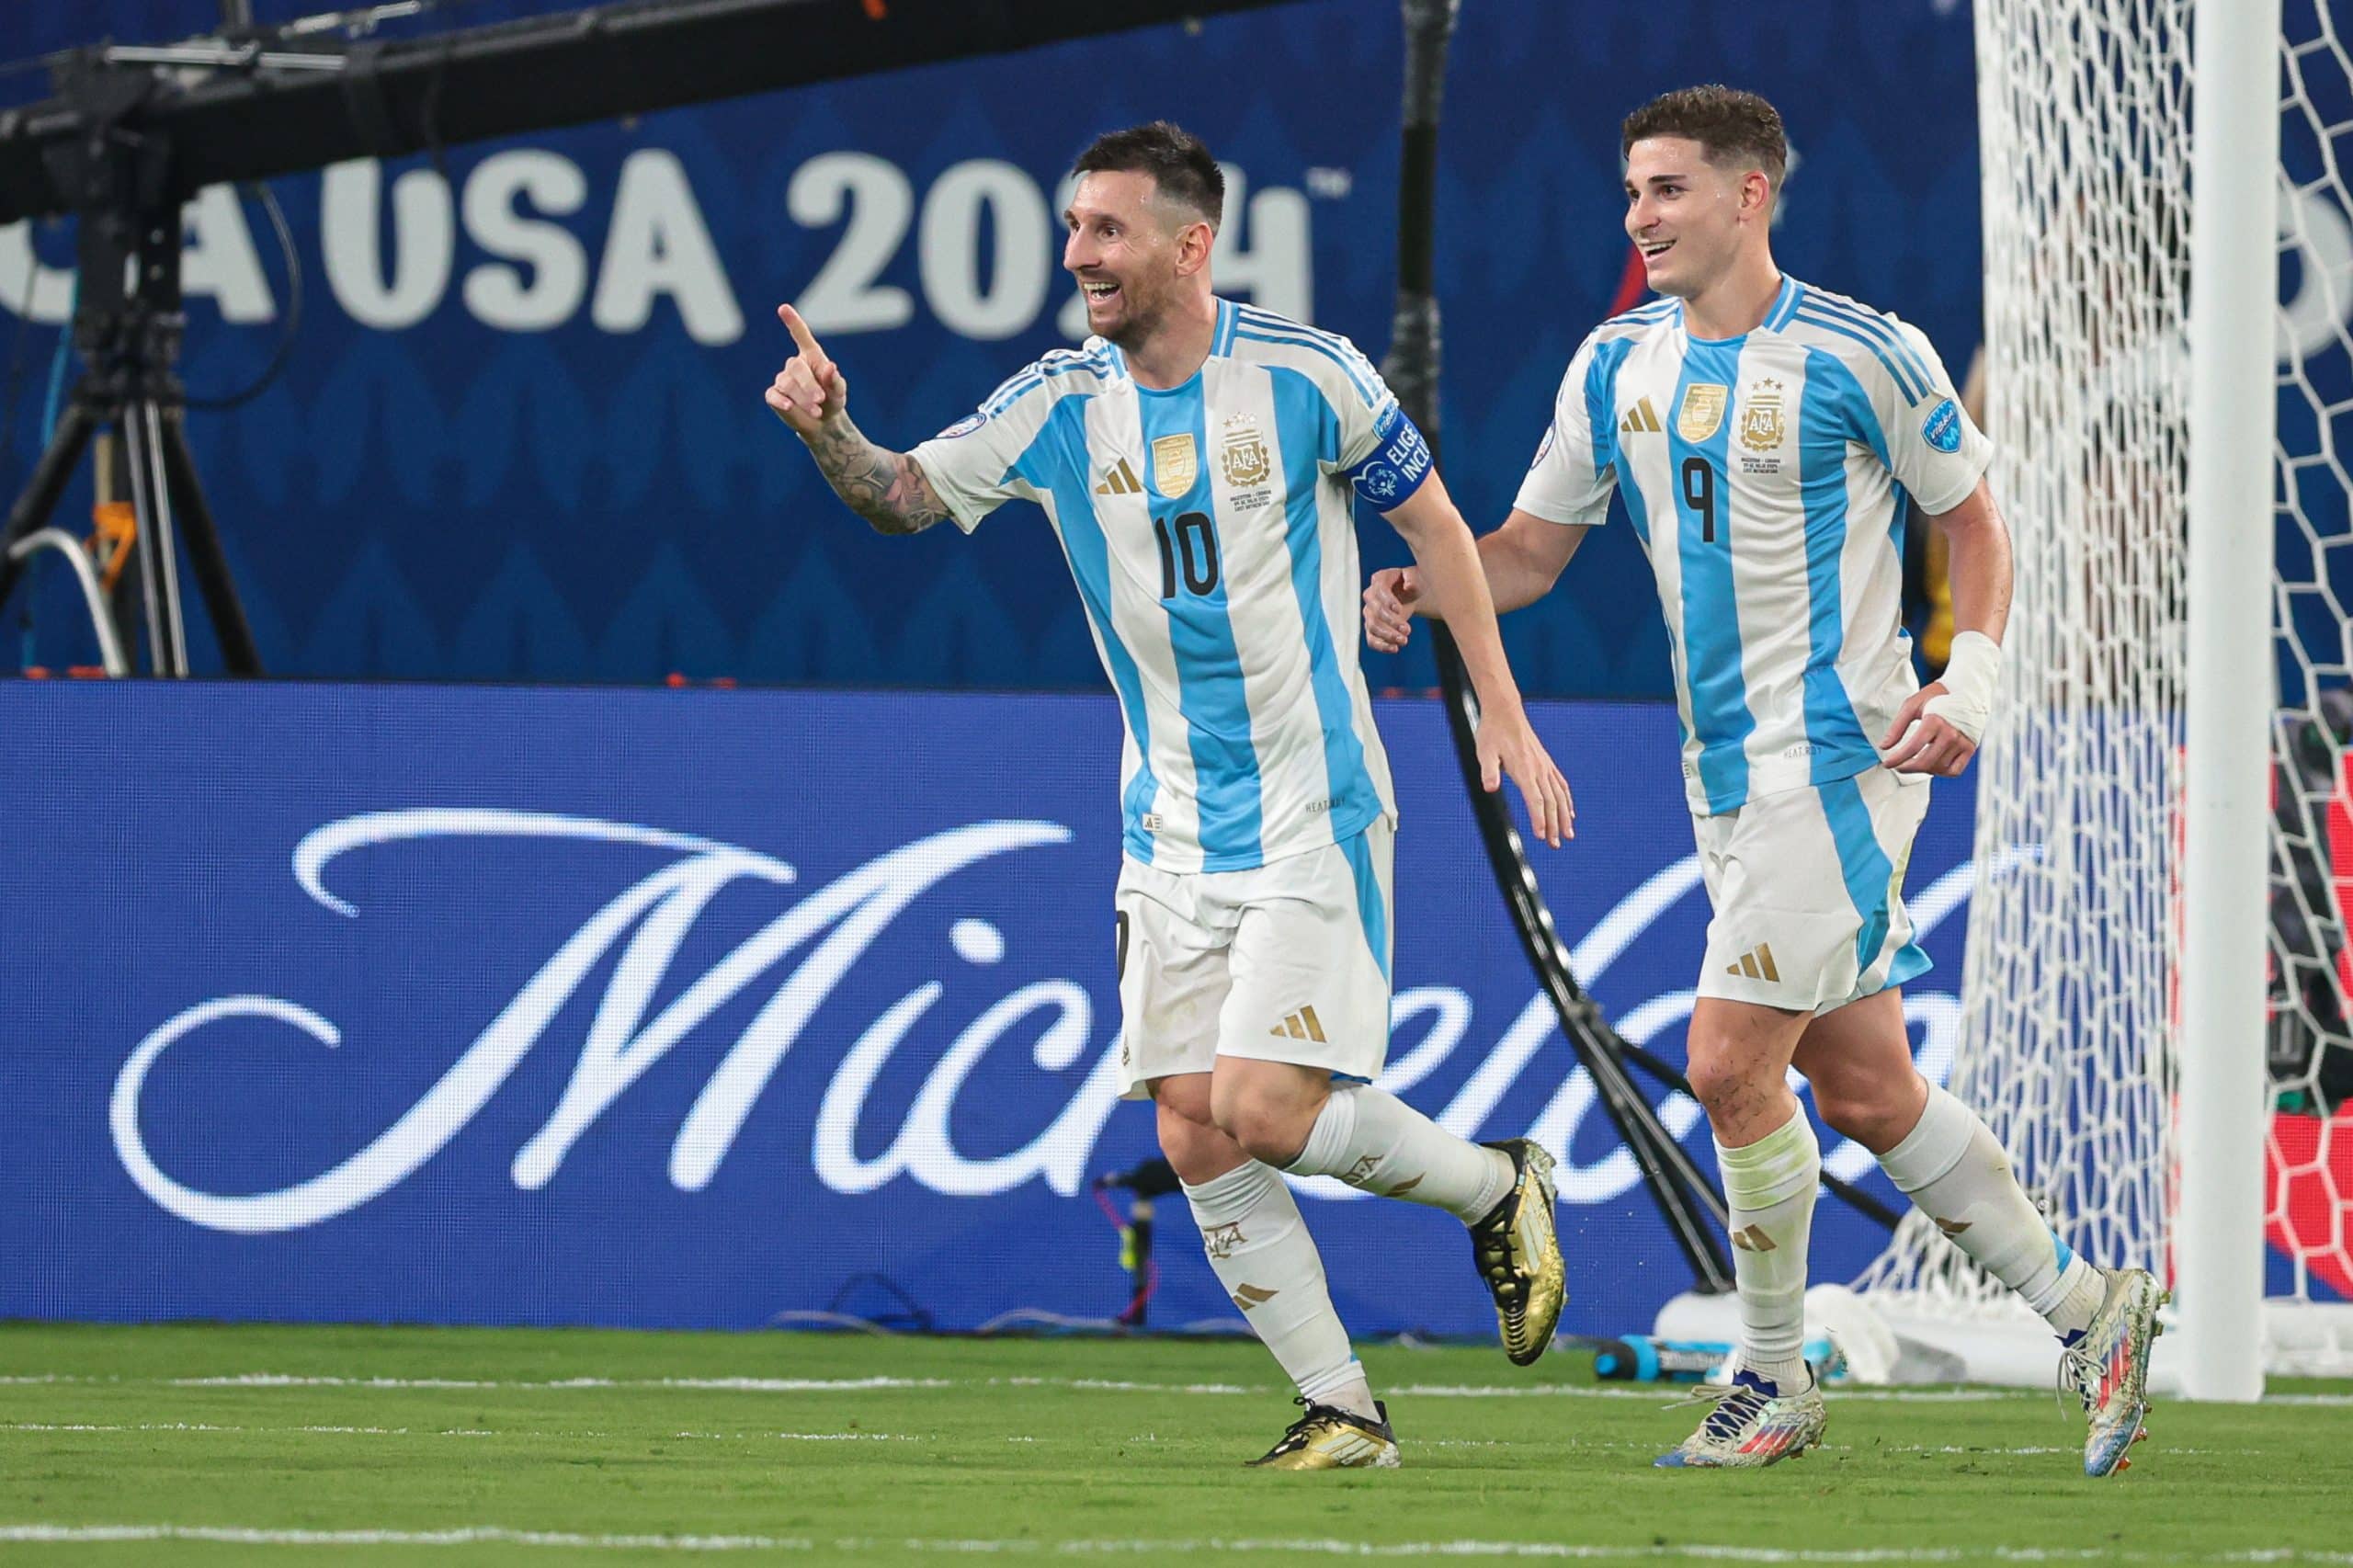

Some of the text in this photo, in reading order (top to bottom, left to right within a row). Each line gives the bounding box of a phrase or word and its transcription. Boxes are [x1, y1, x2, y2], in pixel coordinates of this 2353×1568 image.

[319, 148, 746, 347] USA
[1386, 424, 1419, 466] ELIGE
[1681, 457, 1714, 542] 9
[1155, 512, 1218, 598] 10
[110, 807, 2044, 1233] Micelo
